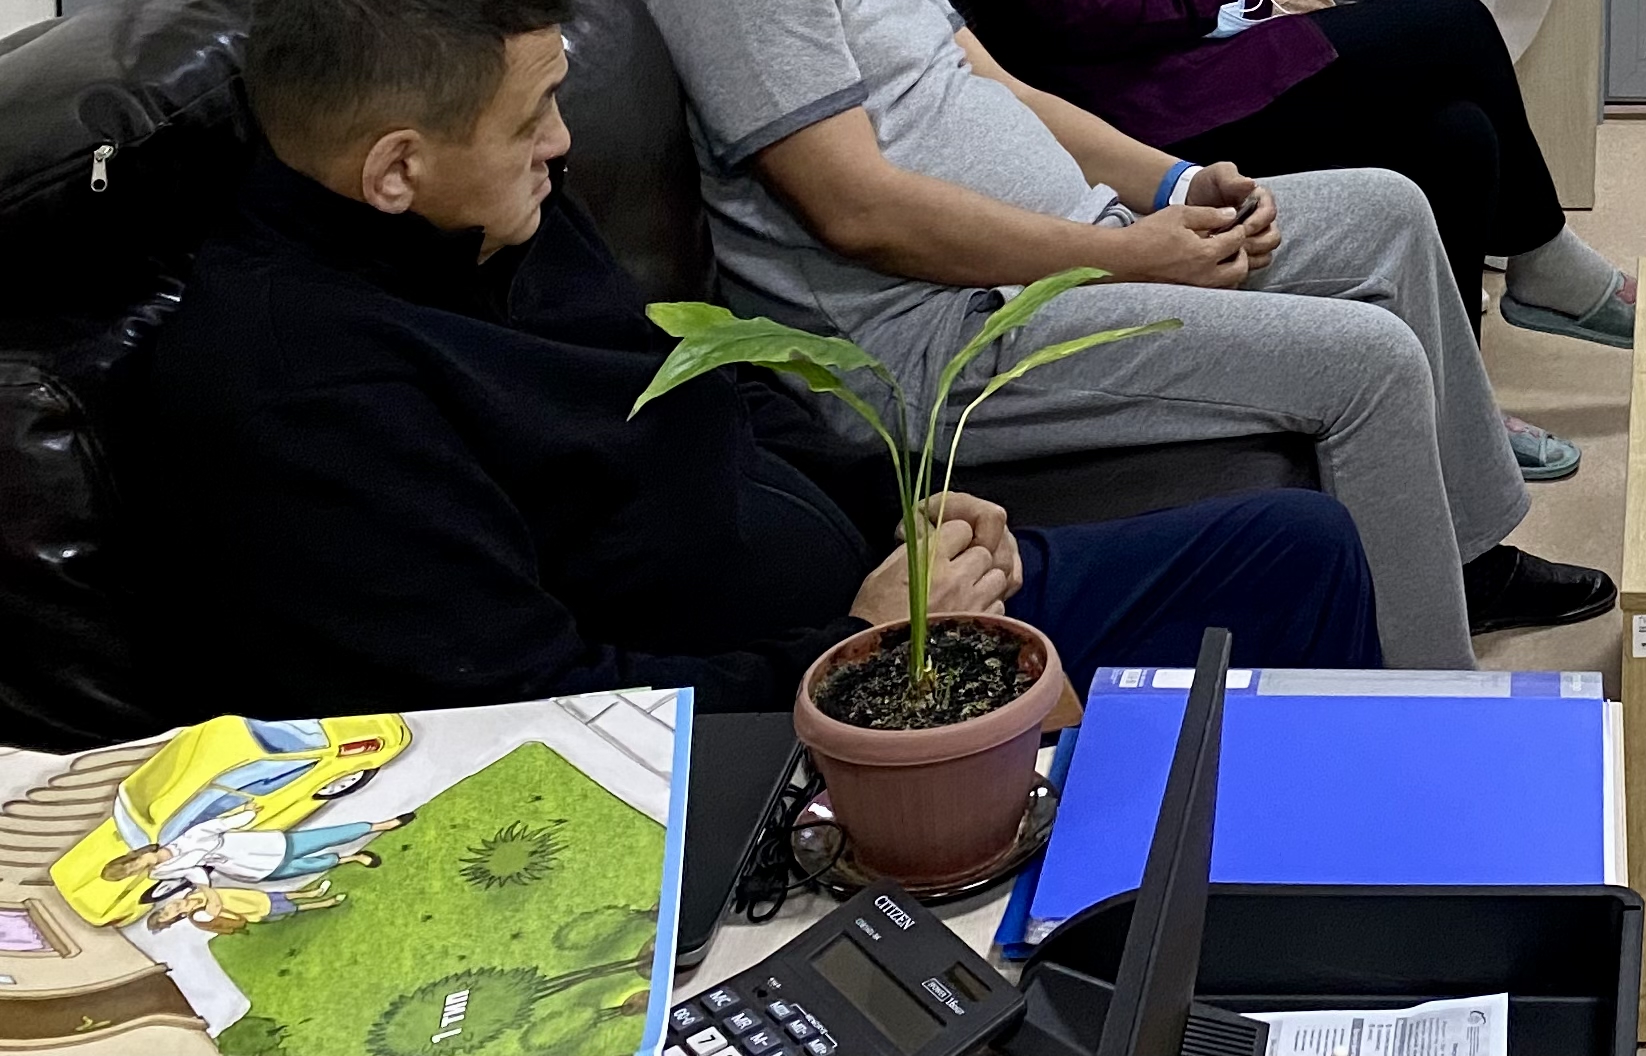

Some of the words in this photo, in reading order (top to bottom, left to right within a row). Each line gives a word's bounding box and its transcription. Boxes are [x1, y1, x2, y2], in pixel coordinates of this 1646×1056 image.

[873, 894, 916, 931] CITIZEN
[709, 989, 732, 1008] MC
[730, 1011, 753, 1031] MR
[430, 1027, 463, 1044] 1
[698, 1034, 716, 1046] 7
